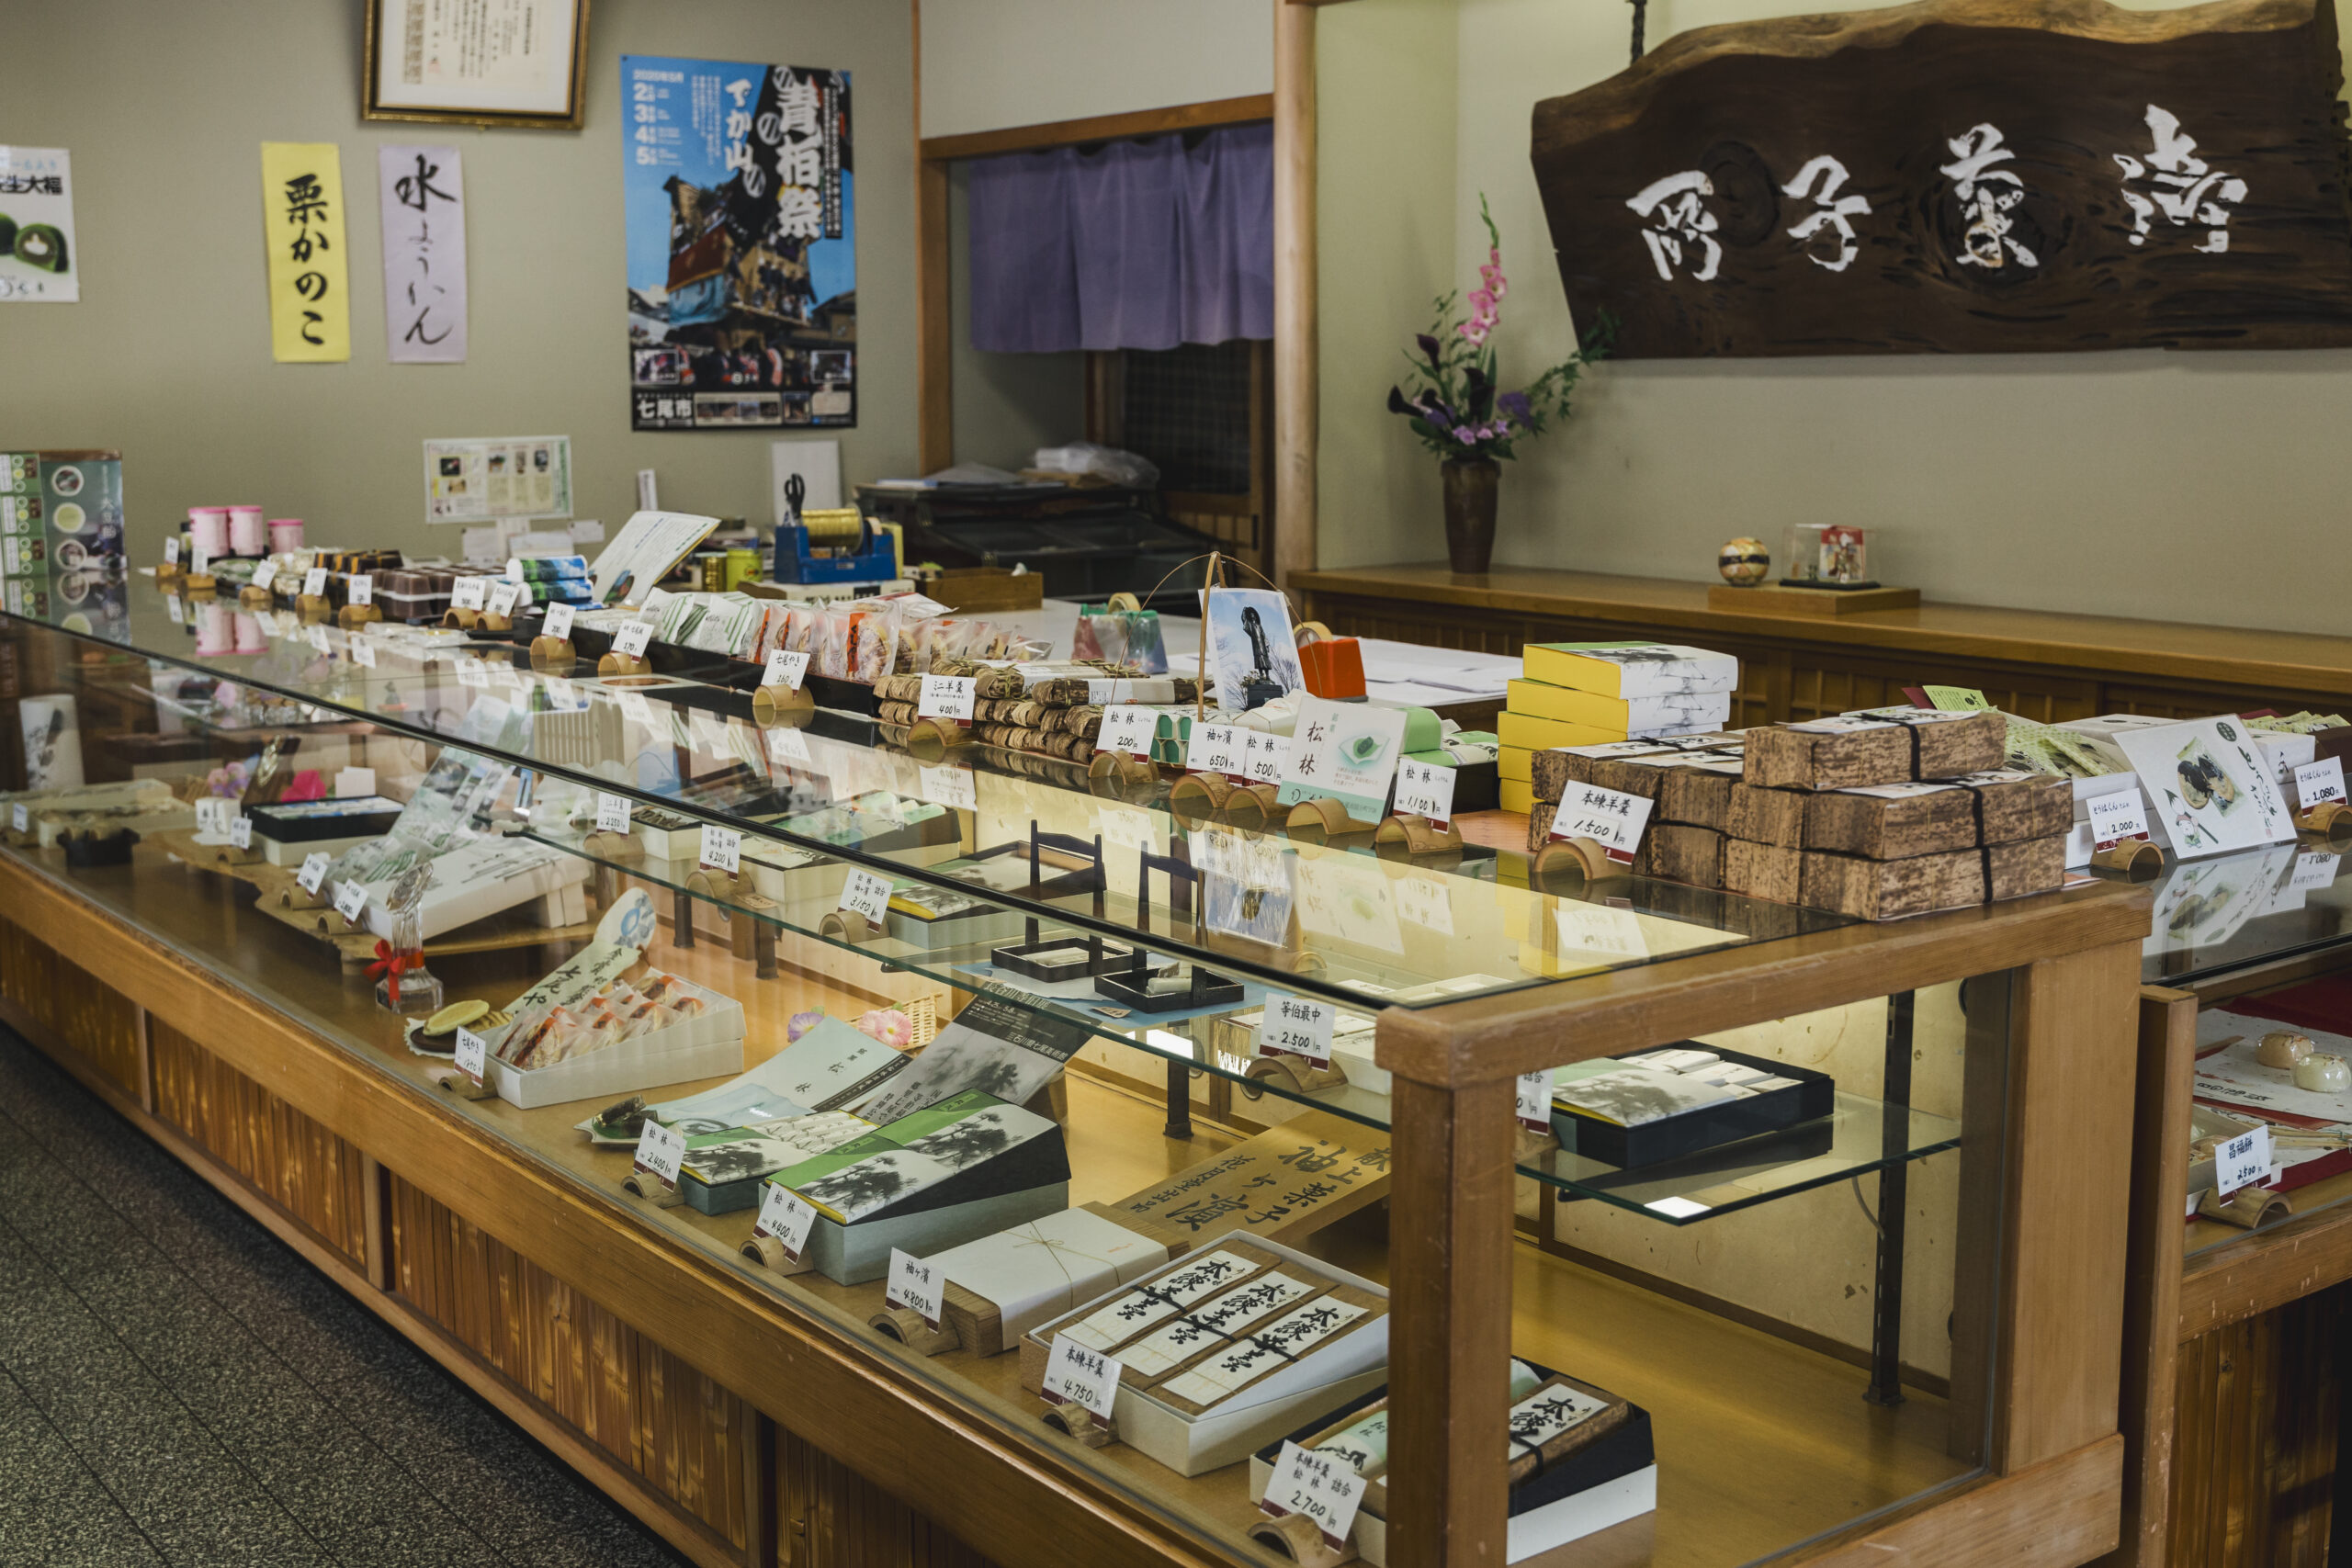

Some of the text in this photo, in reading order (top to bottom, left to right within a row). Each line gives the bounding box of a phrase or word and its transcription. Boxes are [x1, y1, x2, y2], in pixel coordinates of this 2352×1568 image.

[725, 78, 754, 173] でか山
[776, 79, 824, 240] 青柏祭
[285, 173, 331, 346] 栗かのこ
[637, 398, 694, 420] 七尾市
[776, 652, 801, 669] 七尾やき
[1110, 711, 1136, 727] 松林
[1206, 727, 1232, 746] 袖ヶ濱
[1247, 735, 1274, 753] 松林
[1299, 720, 1325, 776] 松林
[1405, 764, 1431, 784] 松林
[1581, 789, 1632, 817] 本練羊羹
[521, 964, 581, 1009] 七尾や
[1280, 999, 1322, 1026] 等伯最中
[648, 1126, 669, 1146] 松林
[773, 1190, 796, 1213] 松林
[904, 1259, 932, 1286] 袖ヶ濱
[1066, 1344, 1105, 1379] 本練羊羹
[1295, 1450, 1332, 1480] 本練羊羹
[1293, 1467, 1353, 1497] 松林 詰合
